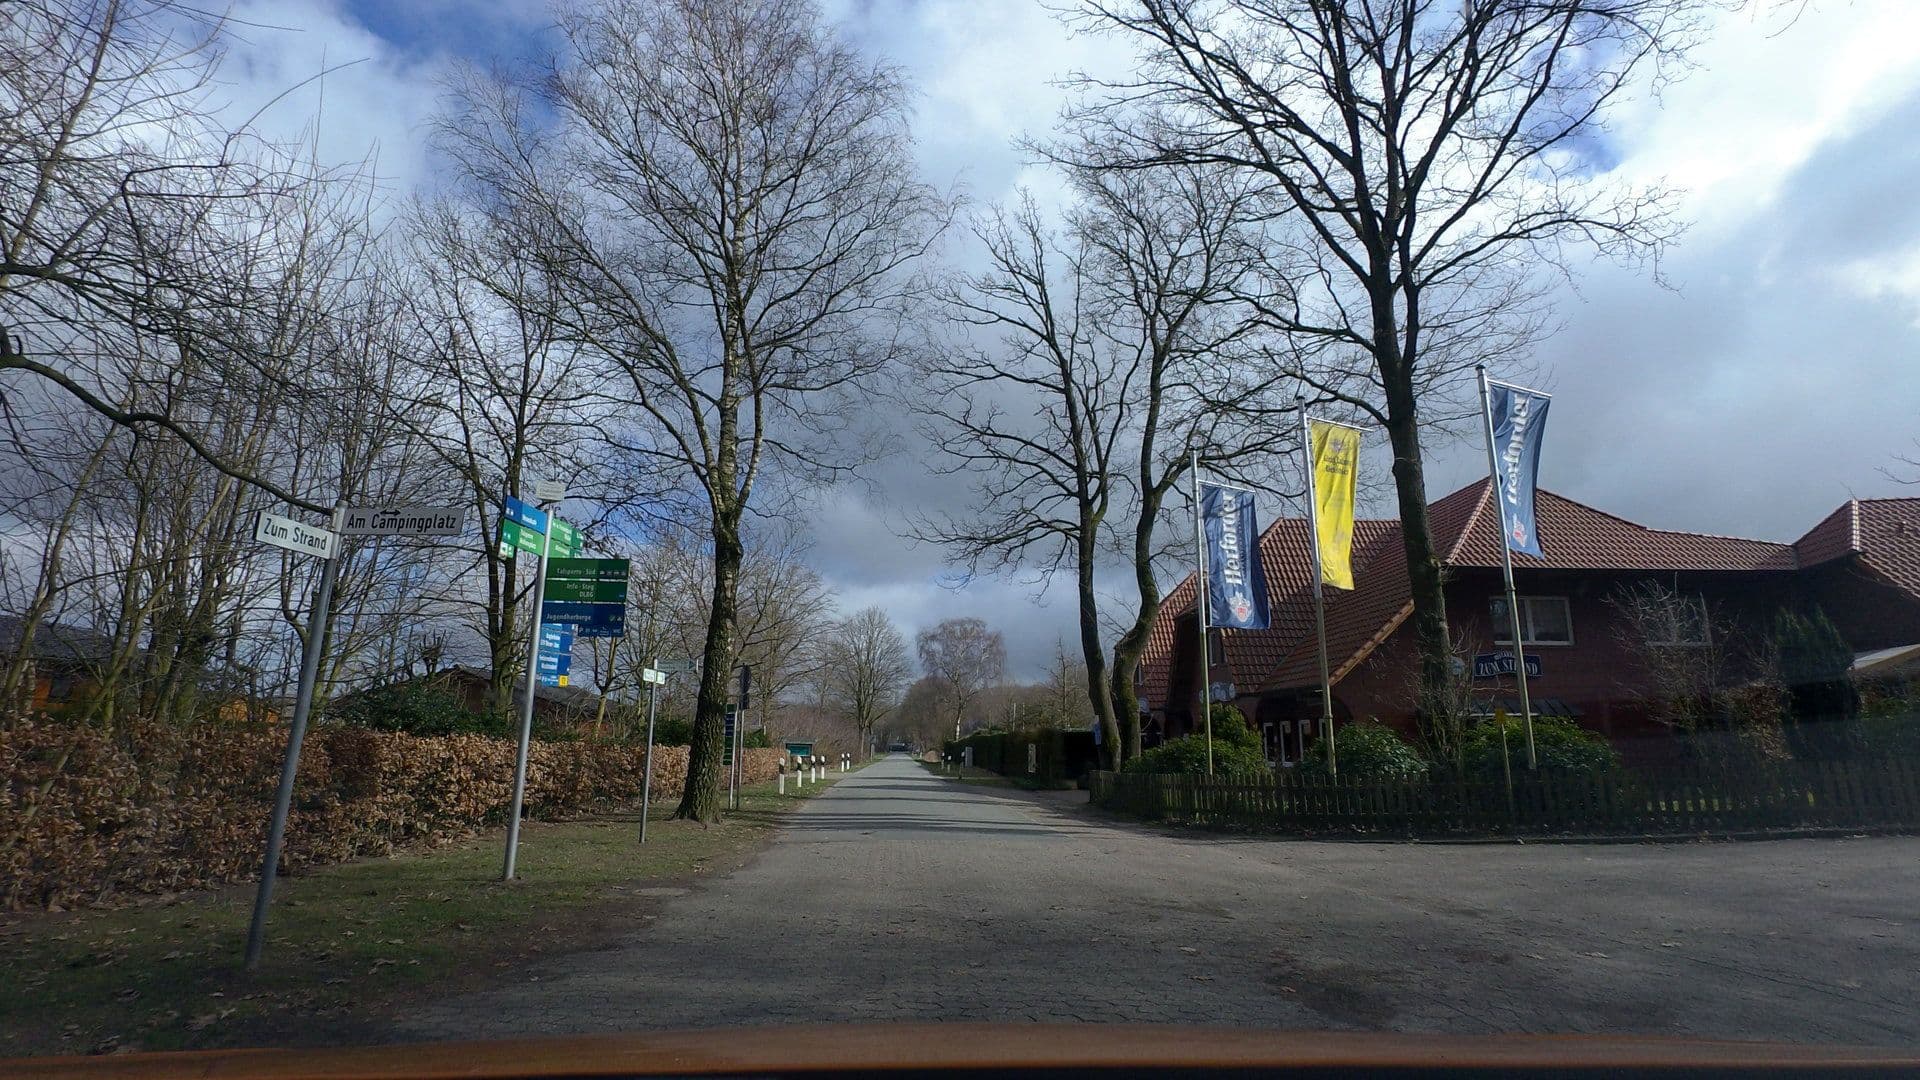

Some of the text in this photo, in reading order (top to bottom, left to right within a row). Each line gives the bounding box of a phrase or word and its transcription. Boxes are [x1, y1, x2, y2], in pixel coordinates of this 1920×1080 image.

[347, 514, 456, 532] Am Campingplatz
[263, 517, 327, 551] Zum Strand
[1219, 491, 1243, 586] Herforder
[546, 613, 591, 622] Jugendherberge
[1478, 659, 1500, 675] ZUM
